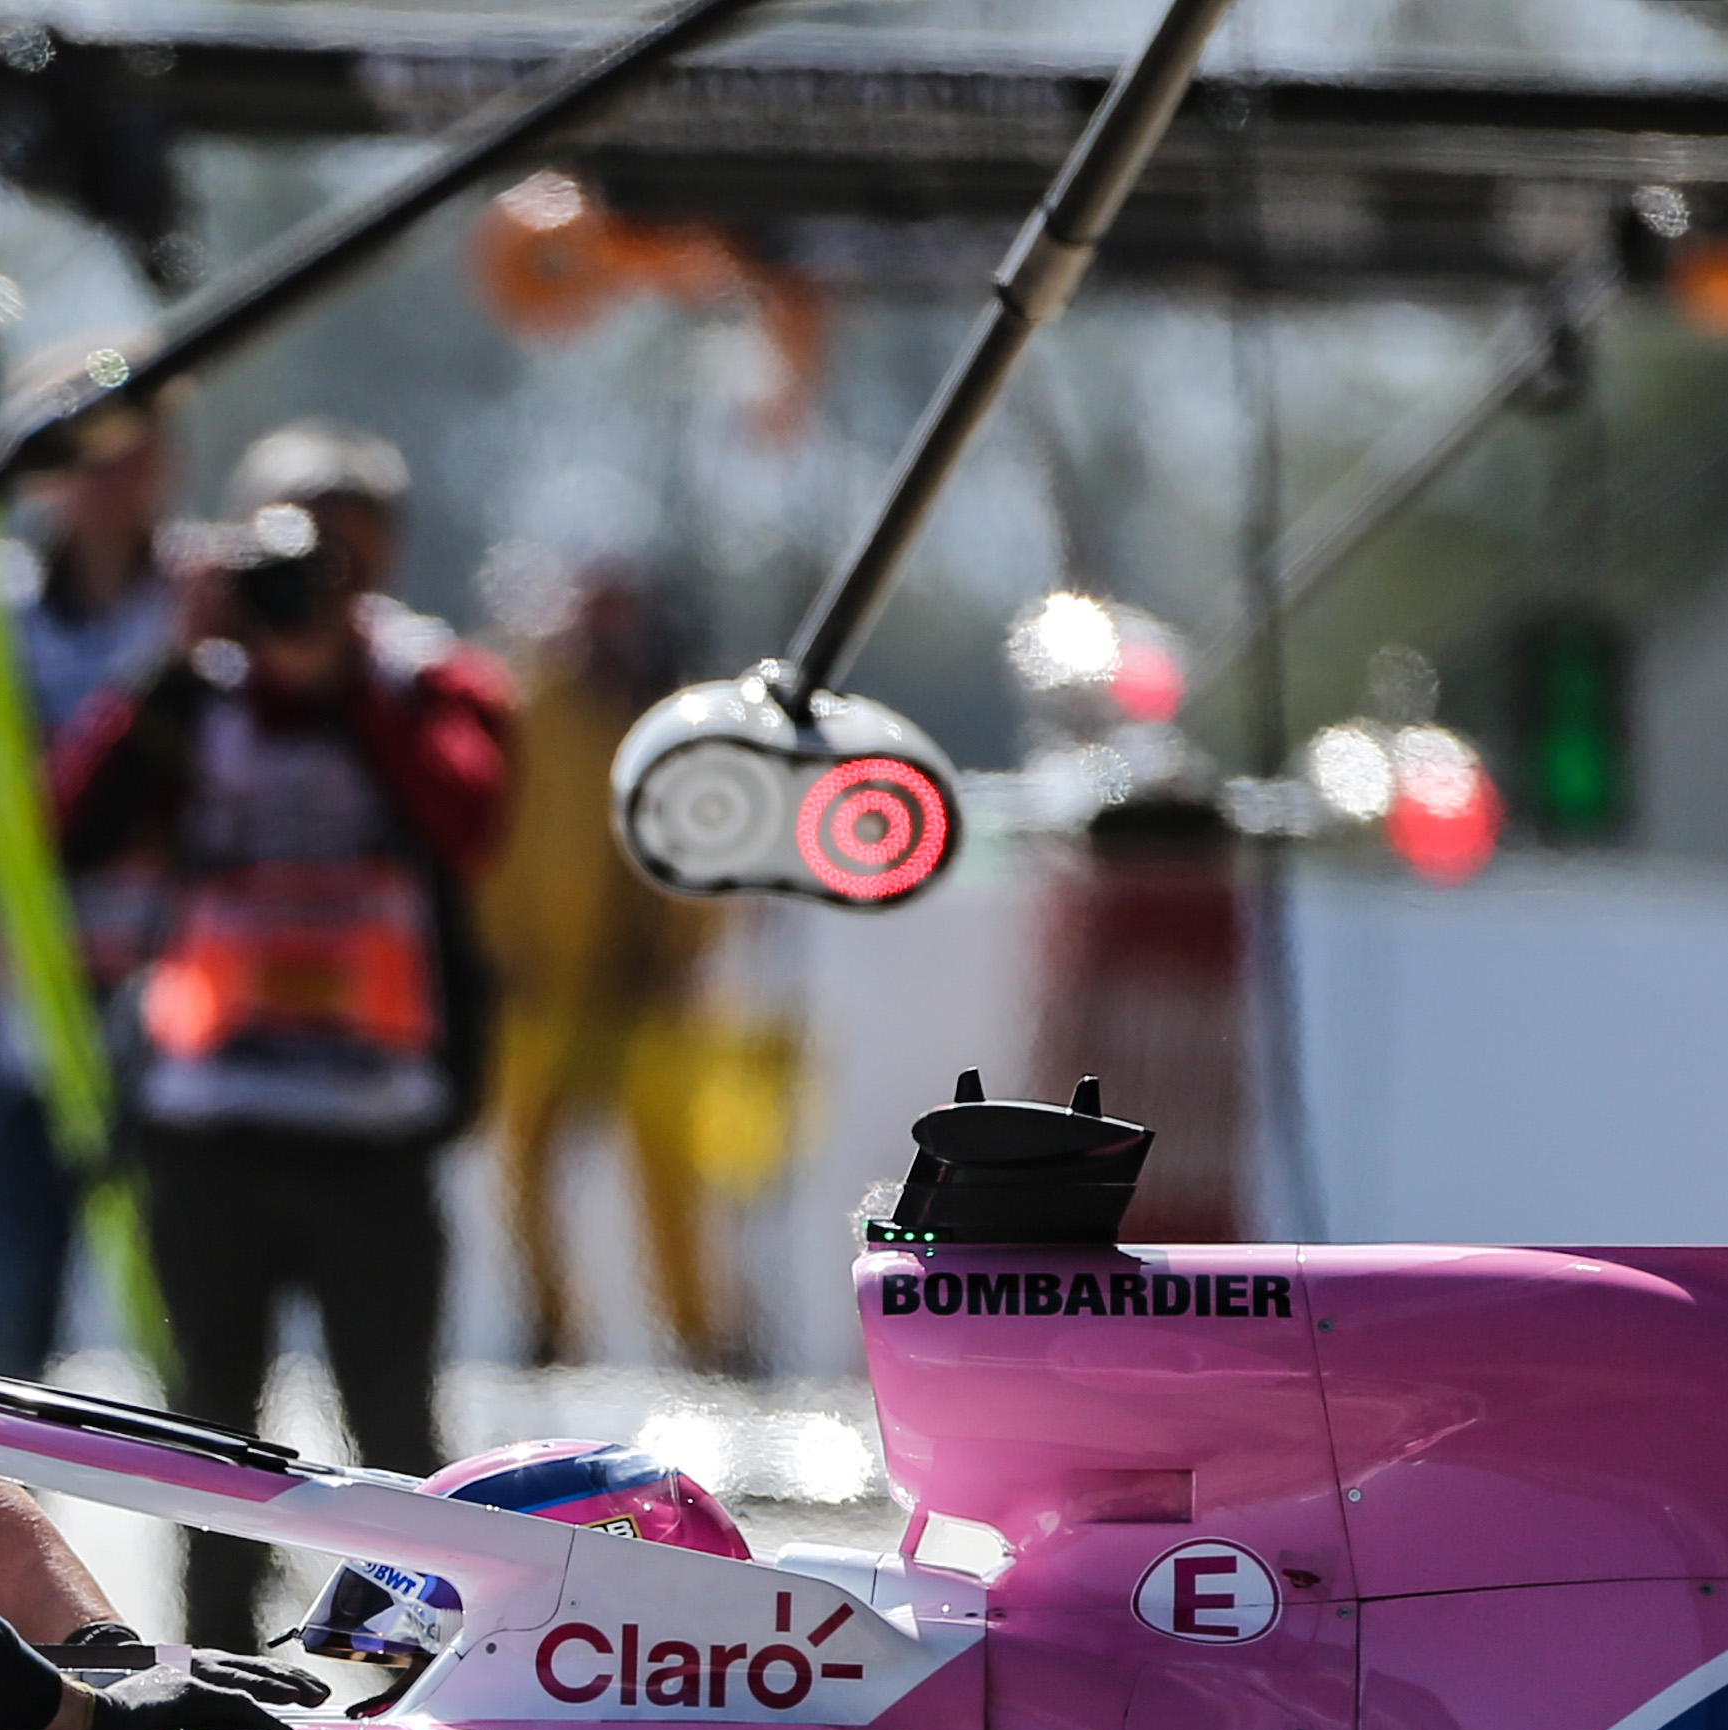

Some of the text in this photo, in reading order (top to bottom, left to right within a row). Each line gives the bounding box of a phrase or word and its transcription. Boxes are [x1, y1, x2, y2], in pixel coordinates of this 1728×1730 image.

[881, 1272, 1294, 1319] BOMBARDIER
[374, 1564, 417, 1595] BWT
[1172, 1555, 1240, 1638] E
[535, 1620, 812, 1711] Claro
